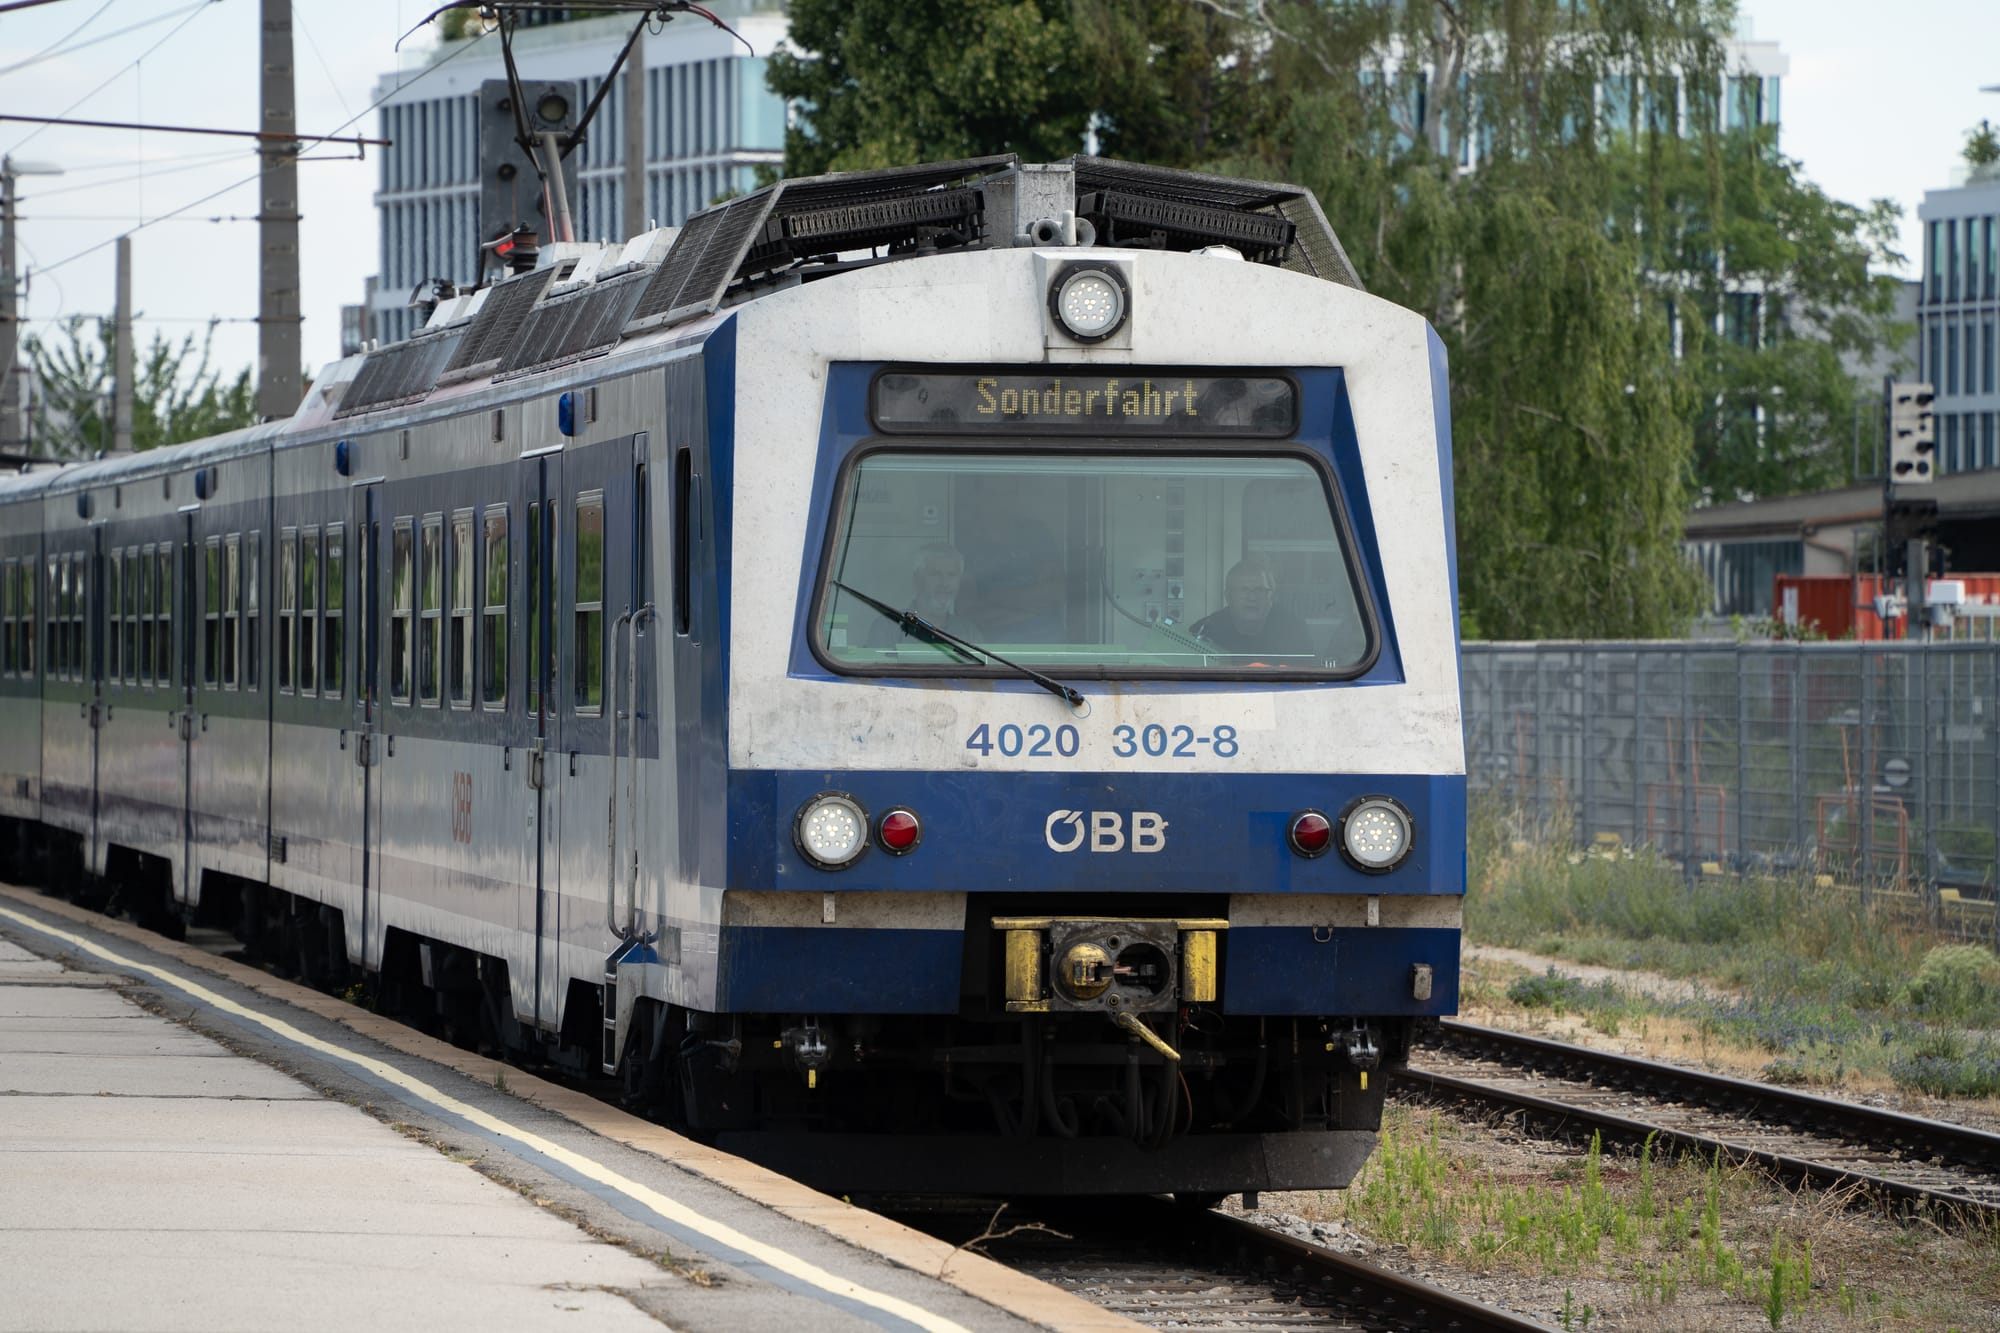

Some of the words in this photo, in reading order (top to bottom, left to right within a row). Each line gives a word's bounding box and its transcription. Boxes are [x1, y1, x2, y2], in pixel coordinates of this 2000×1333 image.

[977, 377, 1199, 416] Sonderfahrt
[966, 723, 1080, 757] 4020
[1112, 724, 1239, 758] 302-8
[1045, 809, 1169, 853] ÖBB
